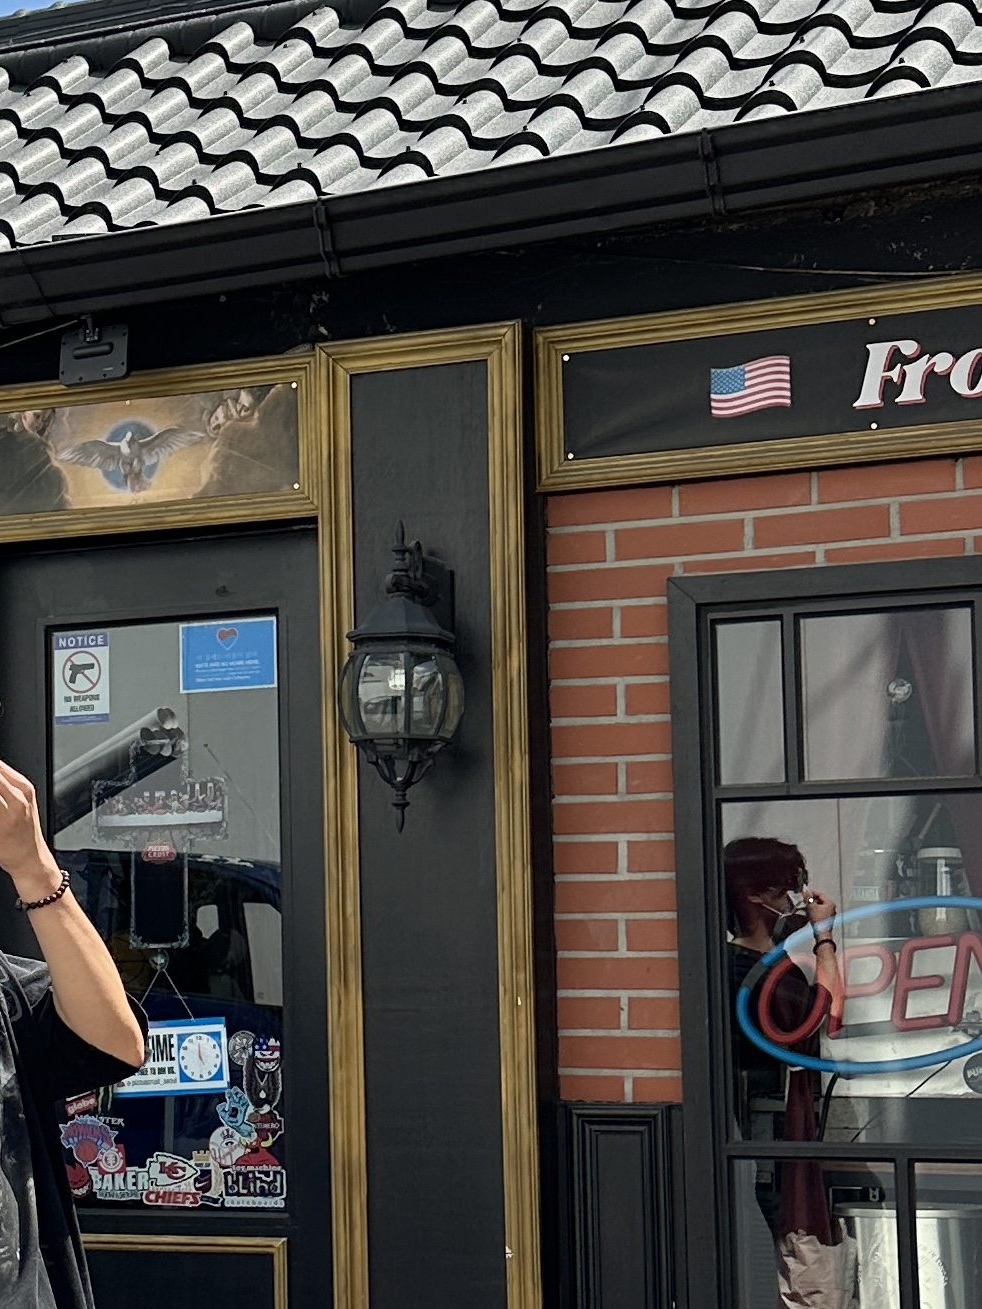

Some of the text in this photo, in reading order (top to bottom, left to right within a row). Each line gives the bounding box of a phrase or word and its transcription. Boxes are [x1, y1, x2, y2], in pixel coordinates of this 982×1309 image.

[852, 340, 982, 408] Fro
[59, 635, 104, 647] NOTICE
[67, 1097, 96, 1114] globe
[159, 1161, 186, 1180] KC
[92, 1171, 150, 1191] BAKER
[144, 1191, 201, 1206] CHIEFS
